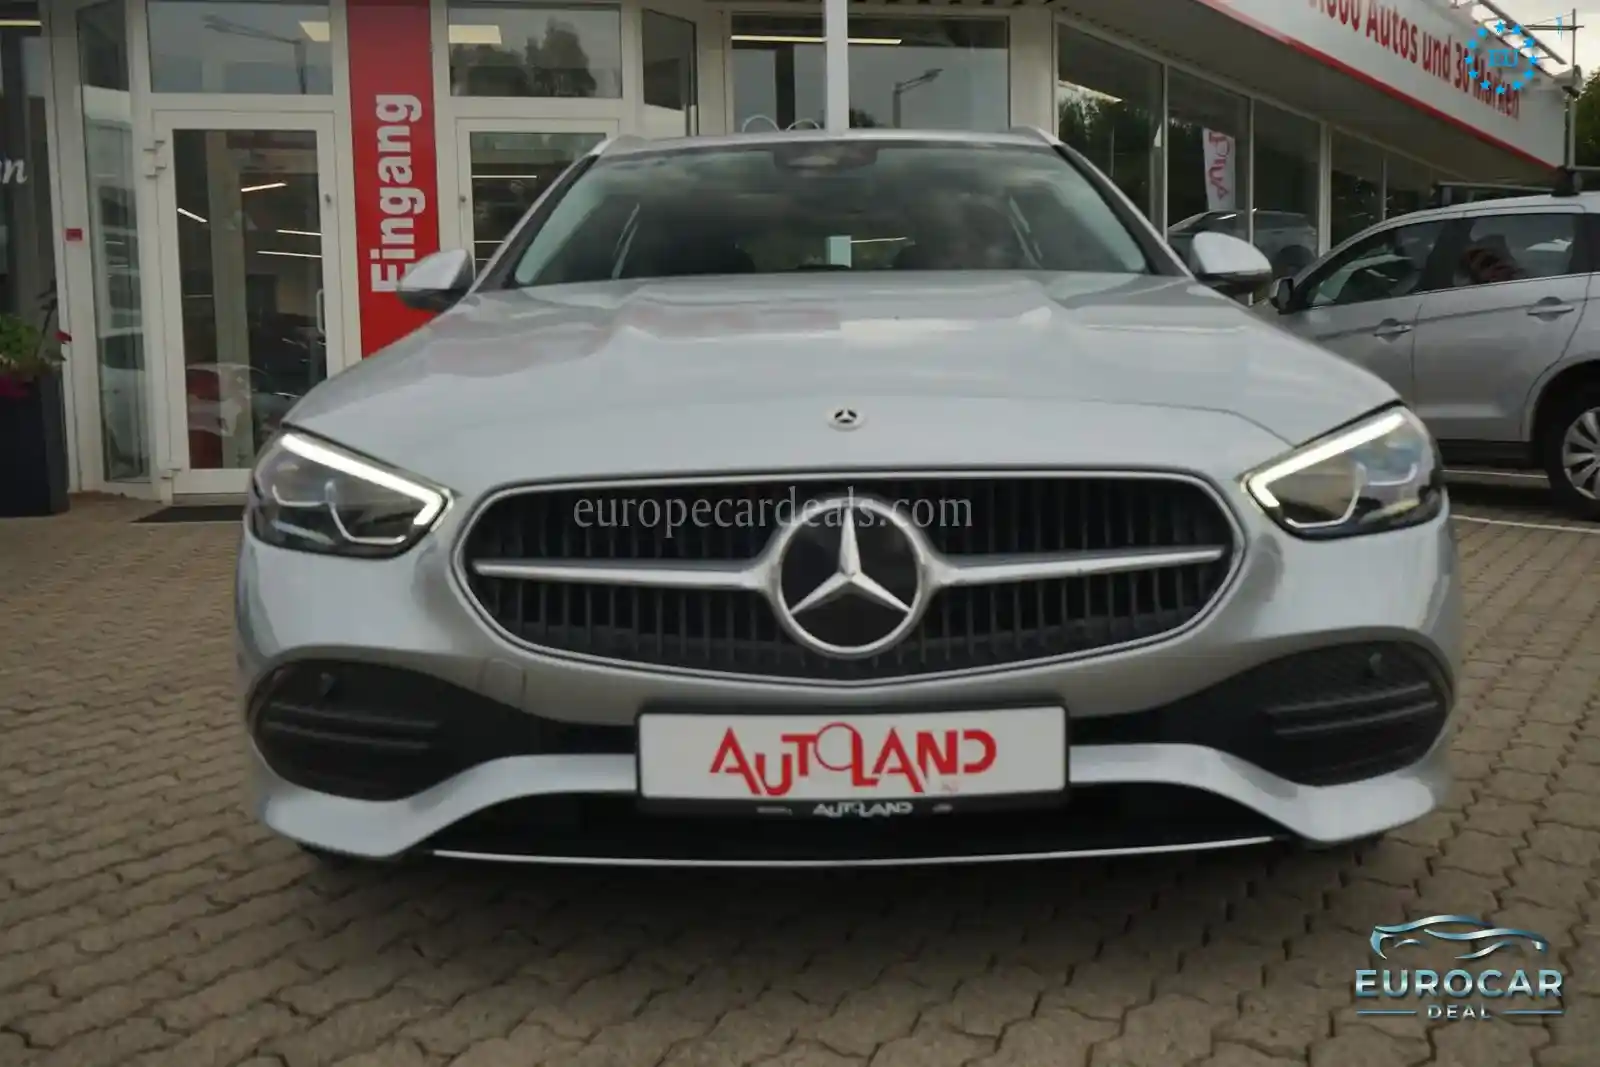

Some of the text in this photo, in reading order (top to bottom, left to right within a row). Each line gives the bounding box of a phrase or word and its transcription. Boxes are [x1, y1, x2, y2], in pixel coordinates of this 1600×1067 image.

[1366, 0, 1418, 64] Autos
[1422, 31, 1451, 82] und
[1456, 41, 1471, 93] 30
[370, 94, 426, 292] Eingang
[709, 722, 997, 796] AUTOLAND
[812, 801, 914, 818] AUTOLAND
